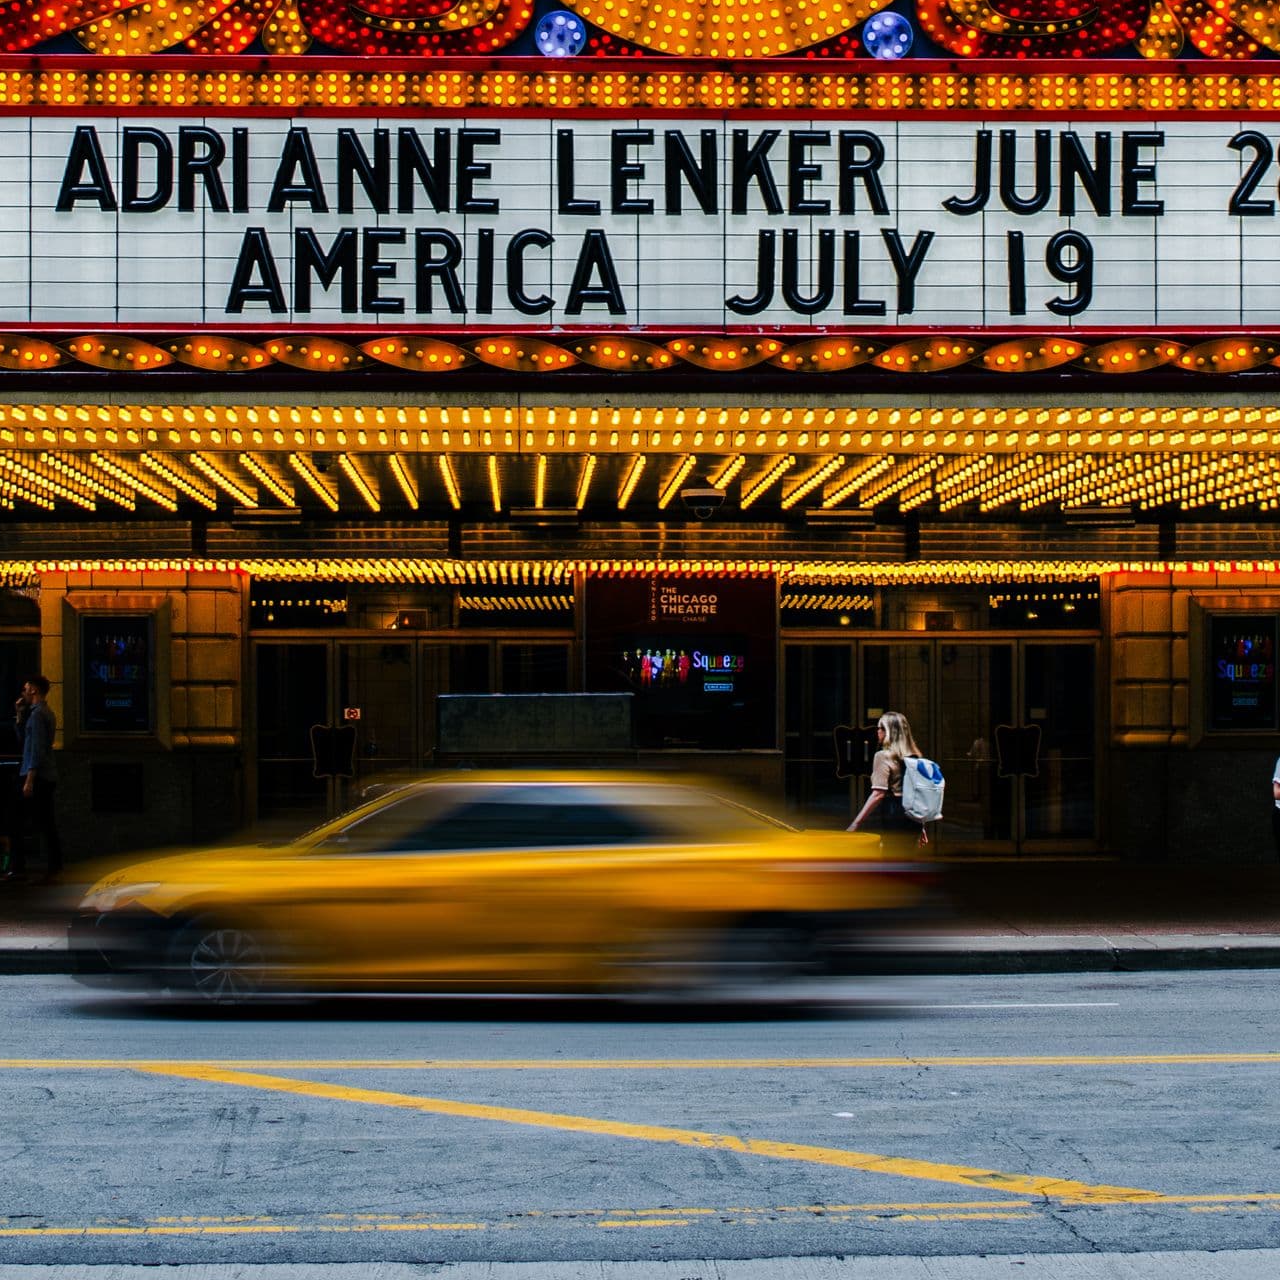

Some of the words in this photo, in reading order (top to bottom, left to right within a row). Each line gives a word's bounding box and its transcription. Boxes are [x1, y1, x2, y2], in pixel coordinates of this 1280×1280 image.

[56, 125, 501, 215] ADRIANNE
[557, 128, 890, 217] LENKER
[942, 129, 1166, 218] JUNE
[225, 226, 628, 317] AMERICA
[728, 228, 936, 318] JULY
[1007, 228, 1095, 319] 19
[660, 586, 677, 594] THE
[660, 594, 718, 604] CHICAGO
[660, 604, 718, 615] THEATRE
[692, 650, 745, 671] Squeeze
